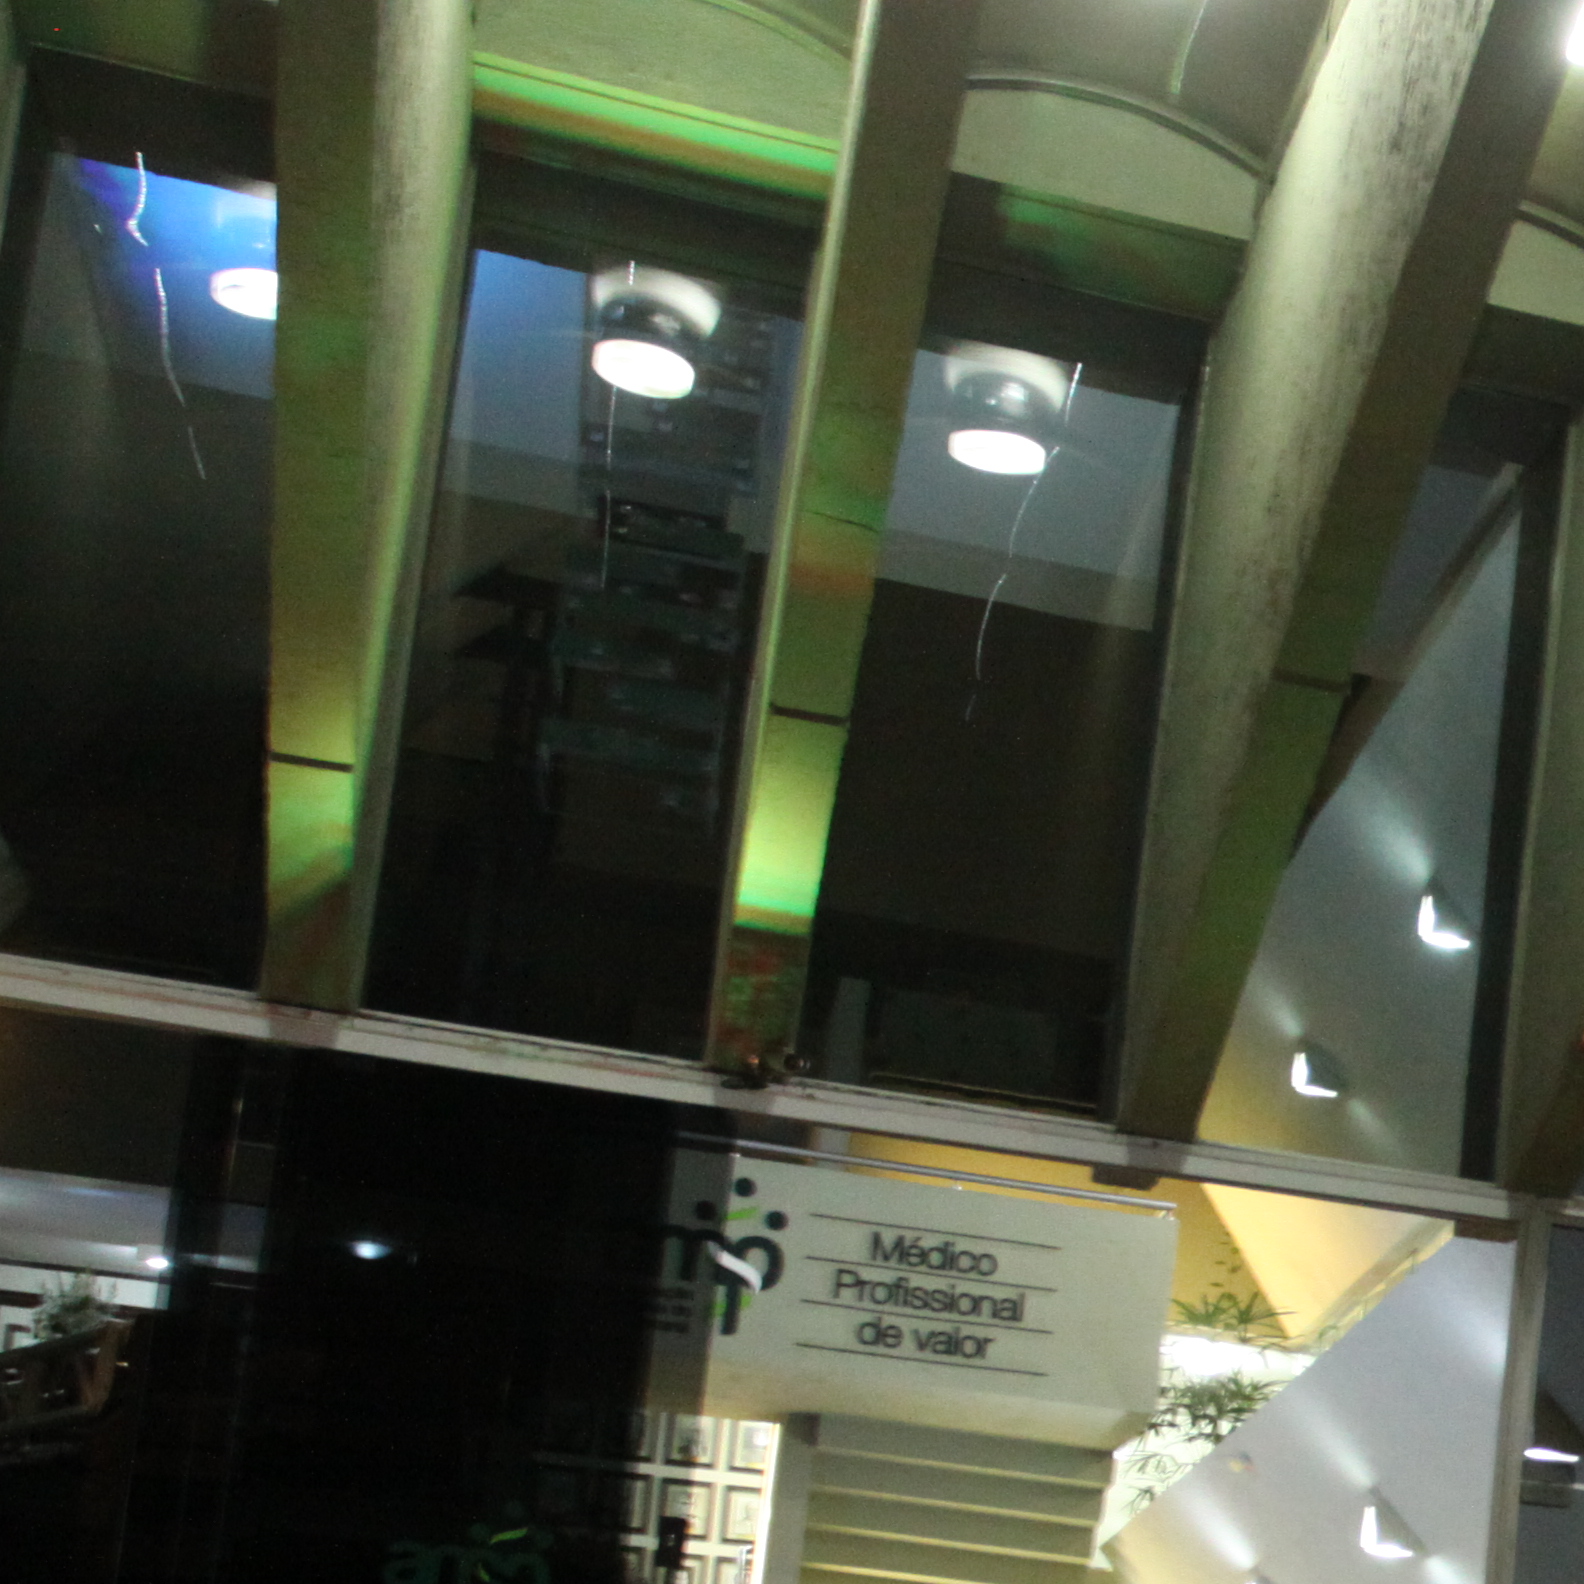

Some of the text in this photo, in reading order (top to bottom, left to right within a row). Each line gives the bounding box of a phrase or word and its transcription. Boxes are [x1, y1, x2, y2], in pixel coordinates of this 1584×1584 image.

[870, 1230, 999, 1277] Médico
[832, 1268, 1027, 1323] Profissional
[856, 1316, 996, 1359] de valor
